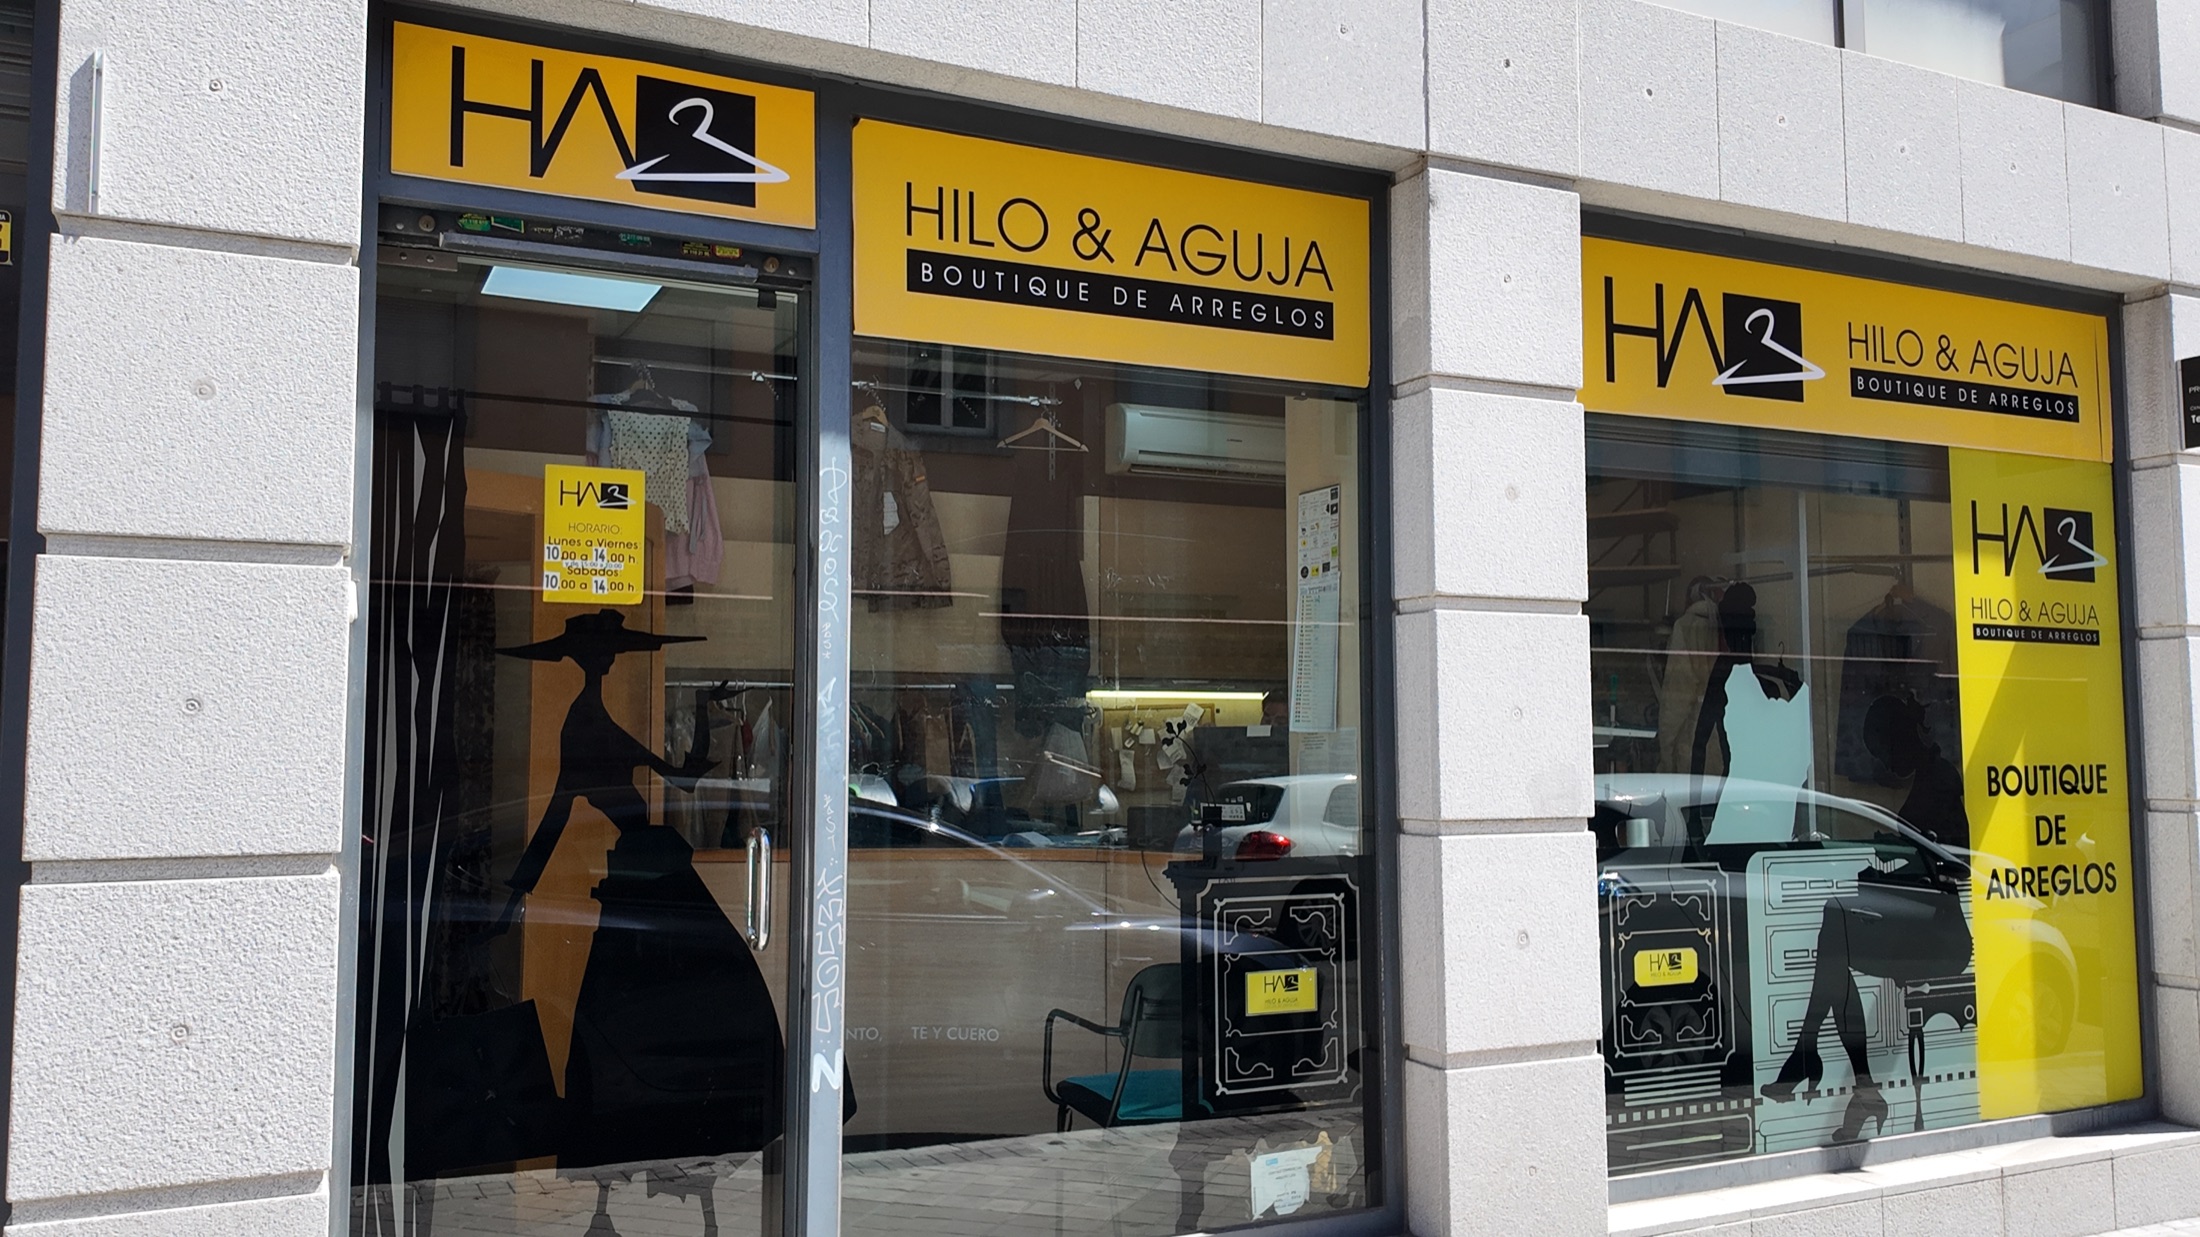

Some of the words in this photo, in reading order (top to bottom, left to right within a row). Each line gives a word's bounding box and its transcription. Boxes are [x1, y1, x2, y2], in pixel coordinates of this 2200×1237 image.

[906, 181, 1048, 252] HILO
[1072, 207, 1115, 264] &
[1135, 218, 1334, 291] AGUJA
[921, 263, 1090, 302] BOUTIQUE
[1114, 286, 1147, 310] DE
[1169, 293, 1325, 330] ARREGLOS
[1848, 321, 1924, 368] HILO
[1936, 333, 1959, 372] &
[1969, 340, 2078, 388] AGUJA
[1856, 376, 1946, 400] BOUTIQUE
[1958, 387, 1979, 405] DE
[1988, 392, 2076, 416] ARREGLOS
[548, 536, 581, 547] Lunes
[580, 582, 588, 590] a
[1971, 597, 2013, 621] HILO
[2018, 600, 2032, 622] &
[2037, 601, 2100, 626] AGUJA
[1976, 627, 2026, 640] BOUTIQUE
[2031, 630, 2042, 640] DE
[2048, 631, 2097, 643] ARREGLOS
[1986, 764, 2108, 797] BOUTIQUE
[2035, 814, 2067, 846] DE
[1986, 861, 2118, 900] ARREGLOS
[911, 1026, 928, 1040] TE
[932, 1027, 942, 1040] Y
[946, 1027, 999, 1042] CUERO
